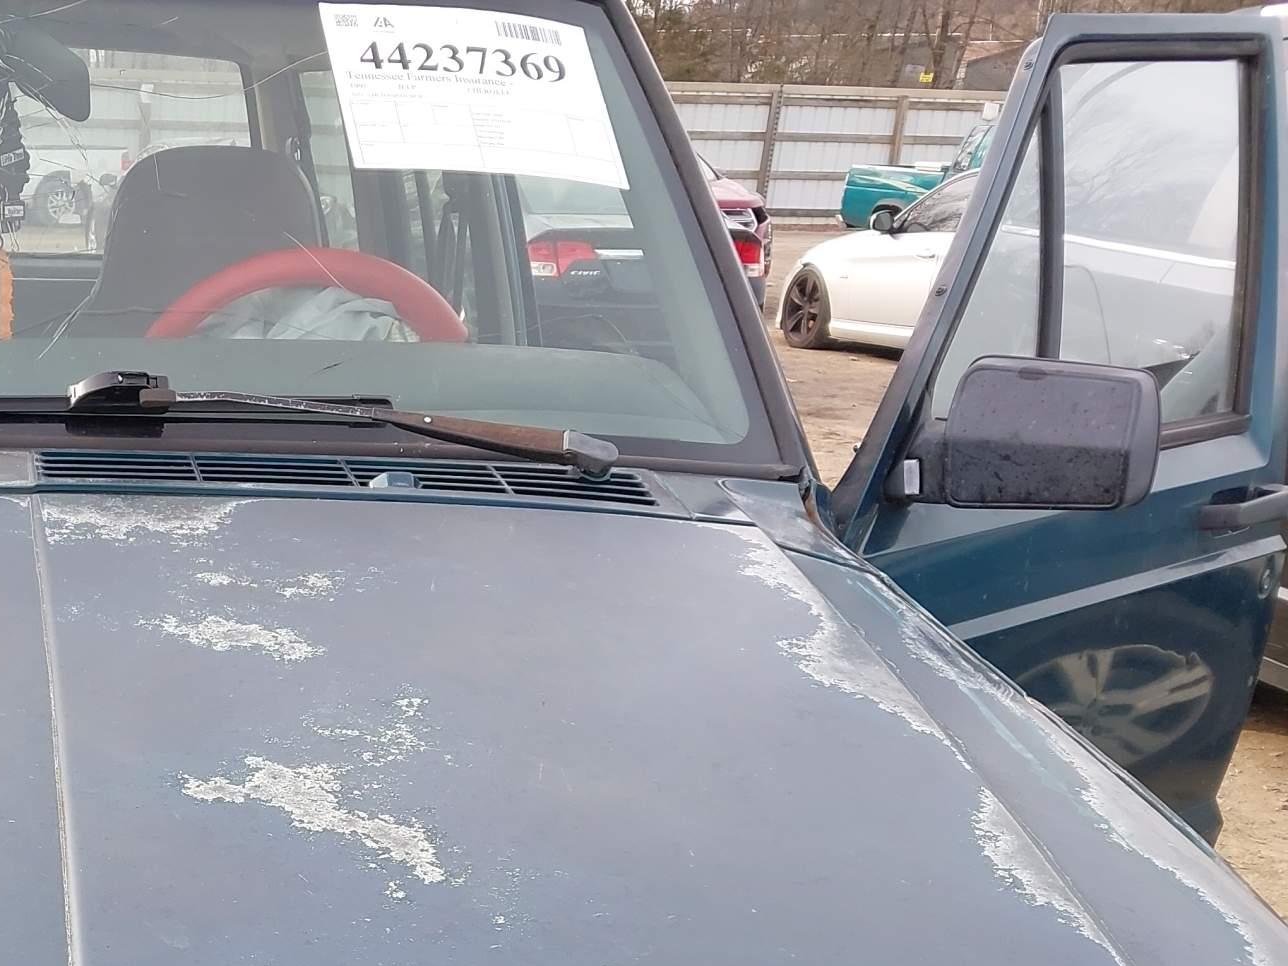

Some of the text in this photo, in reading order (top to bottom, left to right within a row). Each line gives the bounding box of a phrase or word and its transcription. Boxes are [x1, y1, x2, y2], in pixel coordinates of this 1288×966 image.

[360, 40, 567, 83] 44237369
[345, 71, 405, 82] Tennessee
[406, 72, 452, 83] Farmers
[454, 75, 507, 87] Insurance
